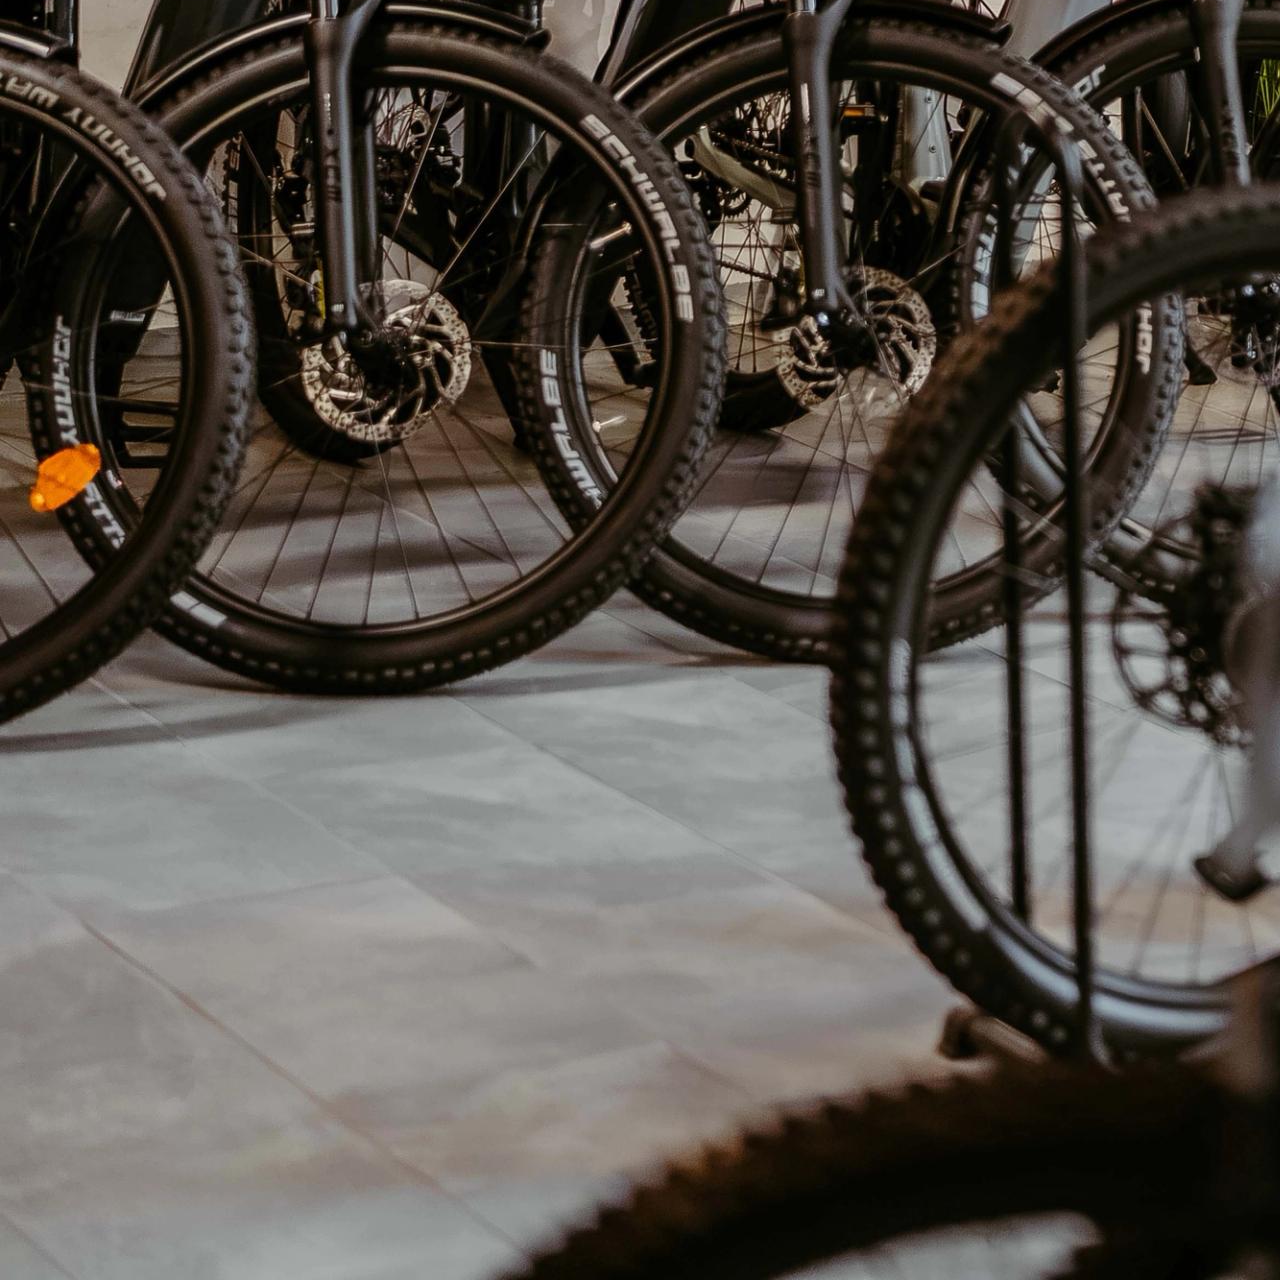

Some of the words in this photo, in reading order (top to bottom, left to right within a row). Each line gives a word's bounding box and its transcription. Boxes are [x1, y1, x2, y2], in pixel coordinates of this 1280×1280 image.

[62, 106, 167, 201] JOHNNY
[580, 113, 695, 322] SCHWALBE
[539, 347, 608, 512] HWALBE
